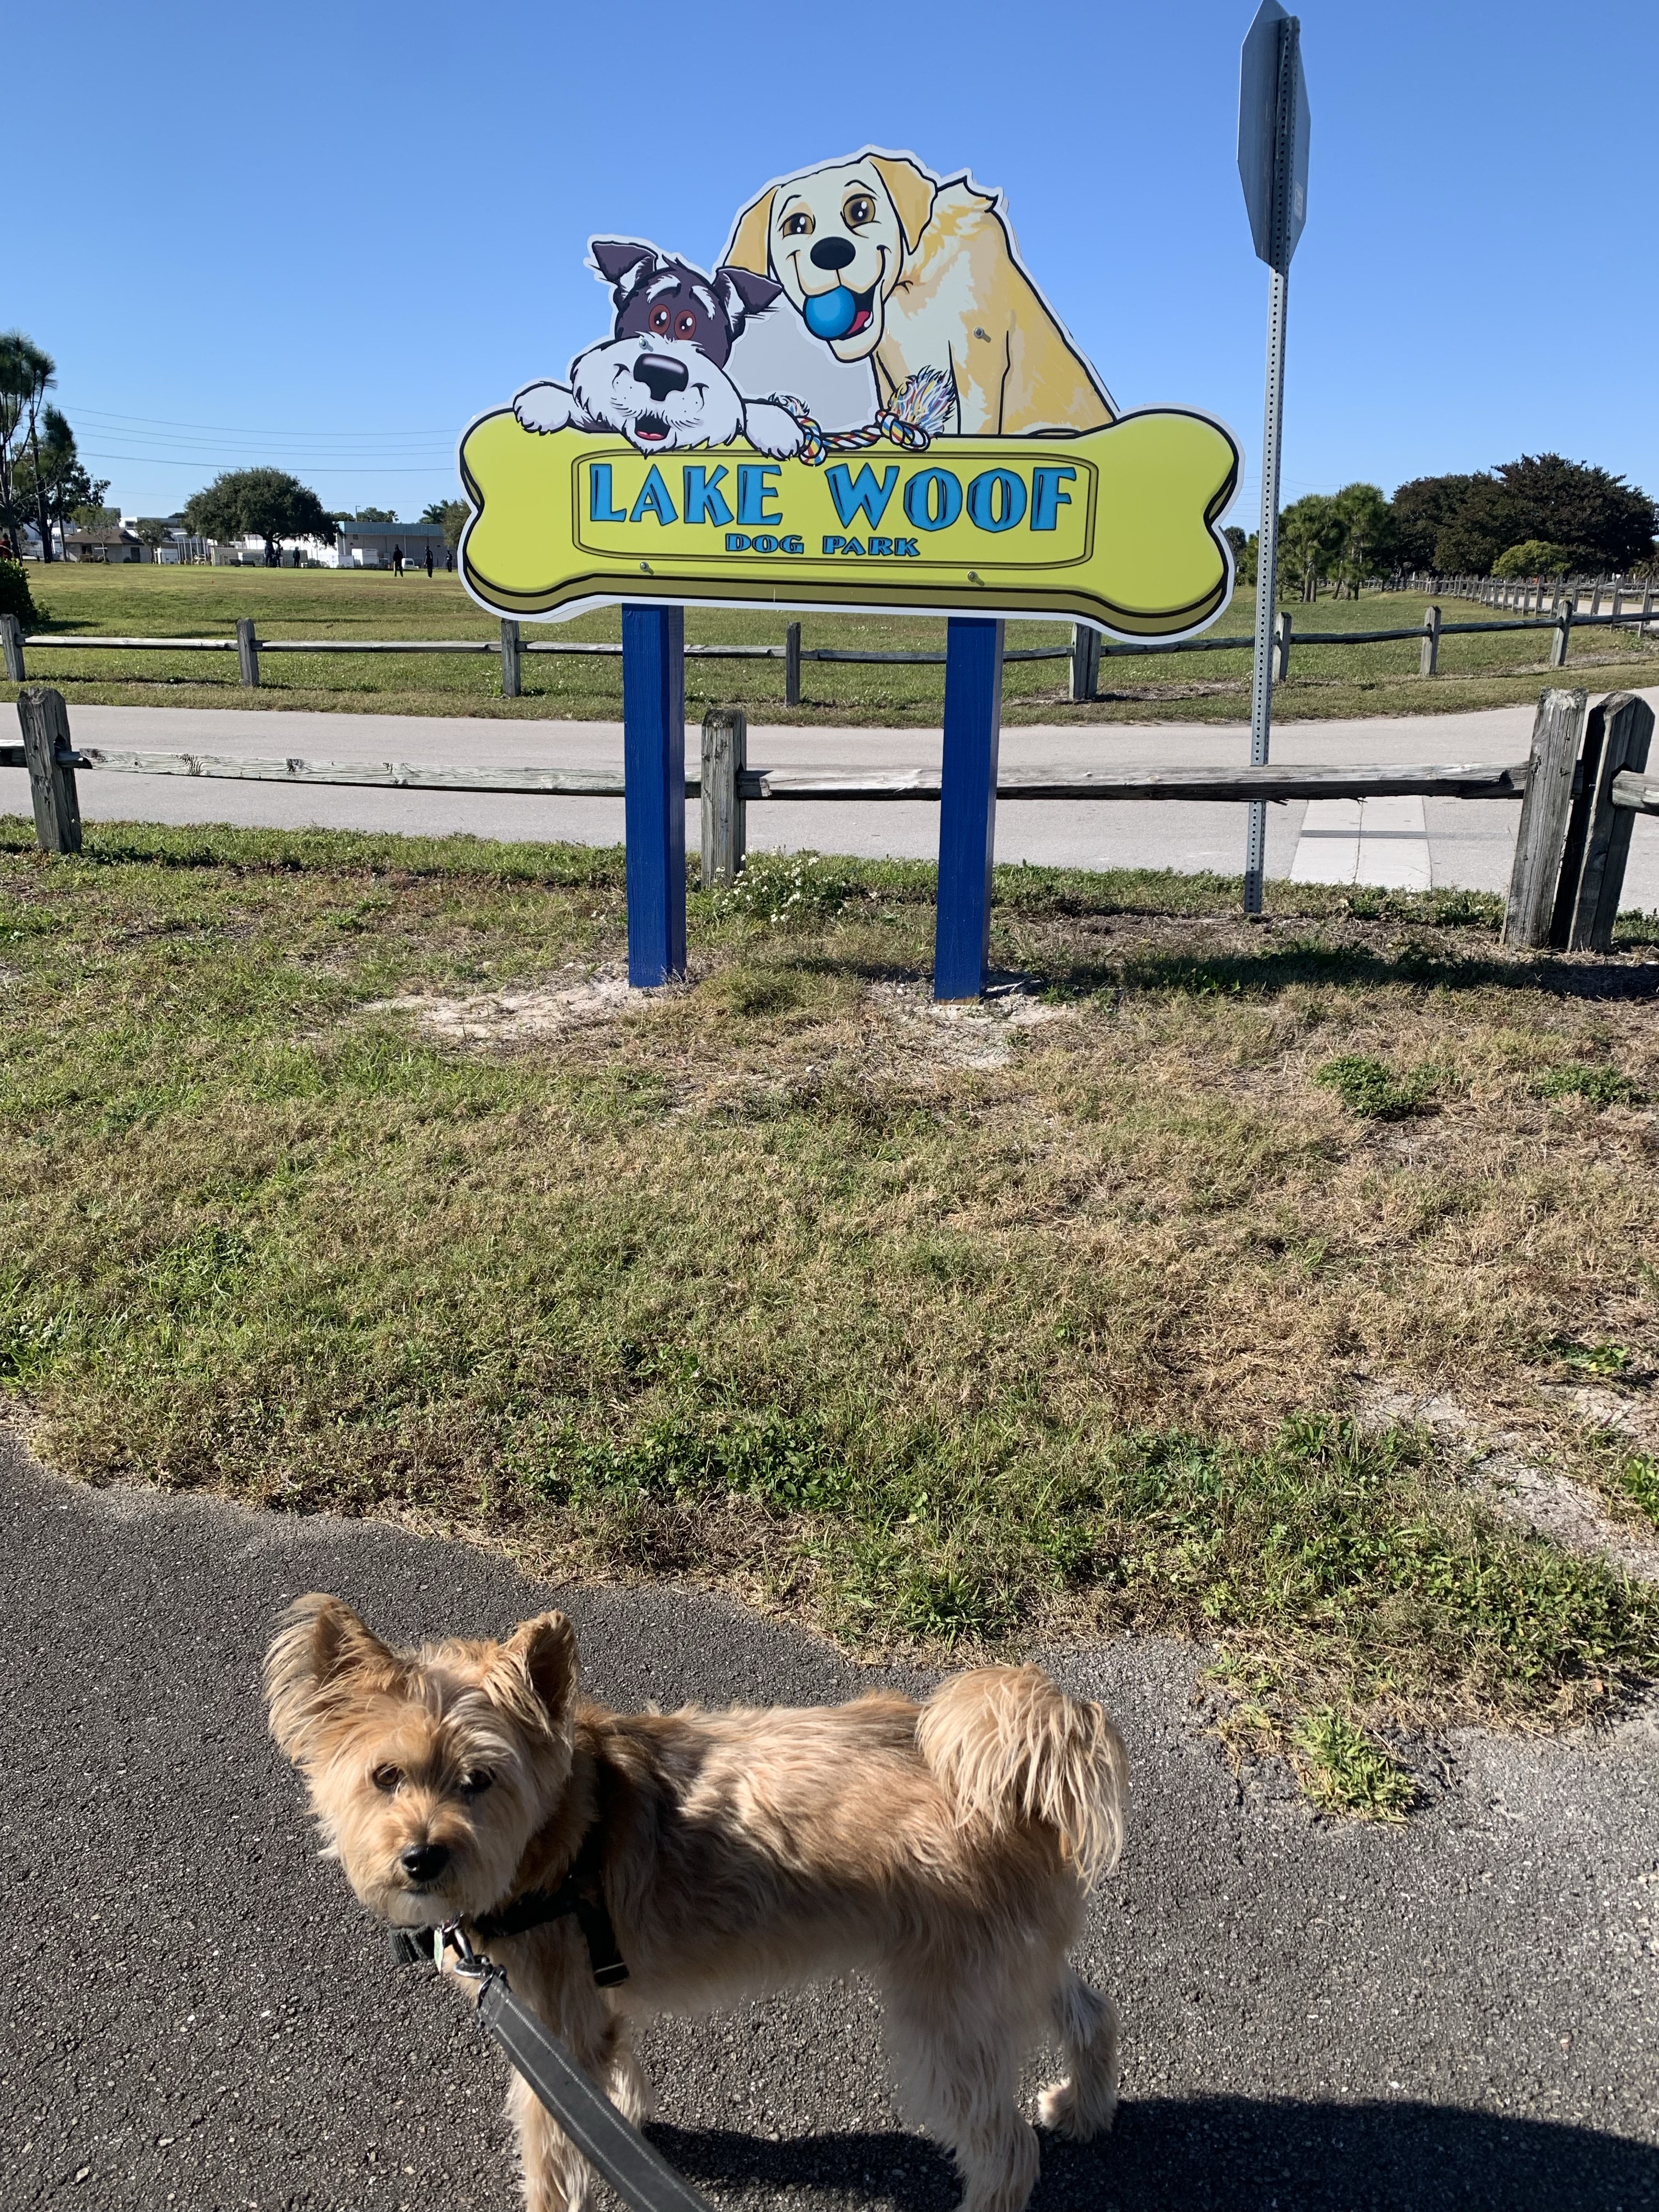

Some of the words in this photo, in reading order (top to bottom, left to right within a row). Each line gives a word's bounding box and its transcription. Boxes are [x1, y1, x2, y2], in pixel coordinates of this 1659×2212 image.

[590, 464, 783, 527] LAKE
[824, 462, 1076, 533] WOOF
[725, 533, 804, 554] DOG
[822, 535, 921, 557] PARK
